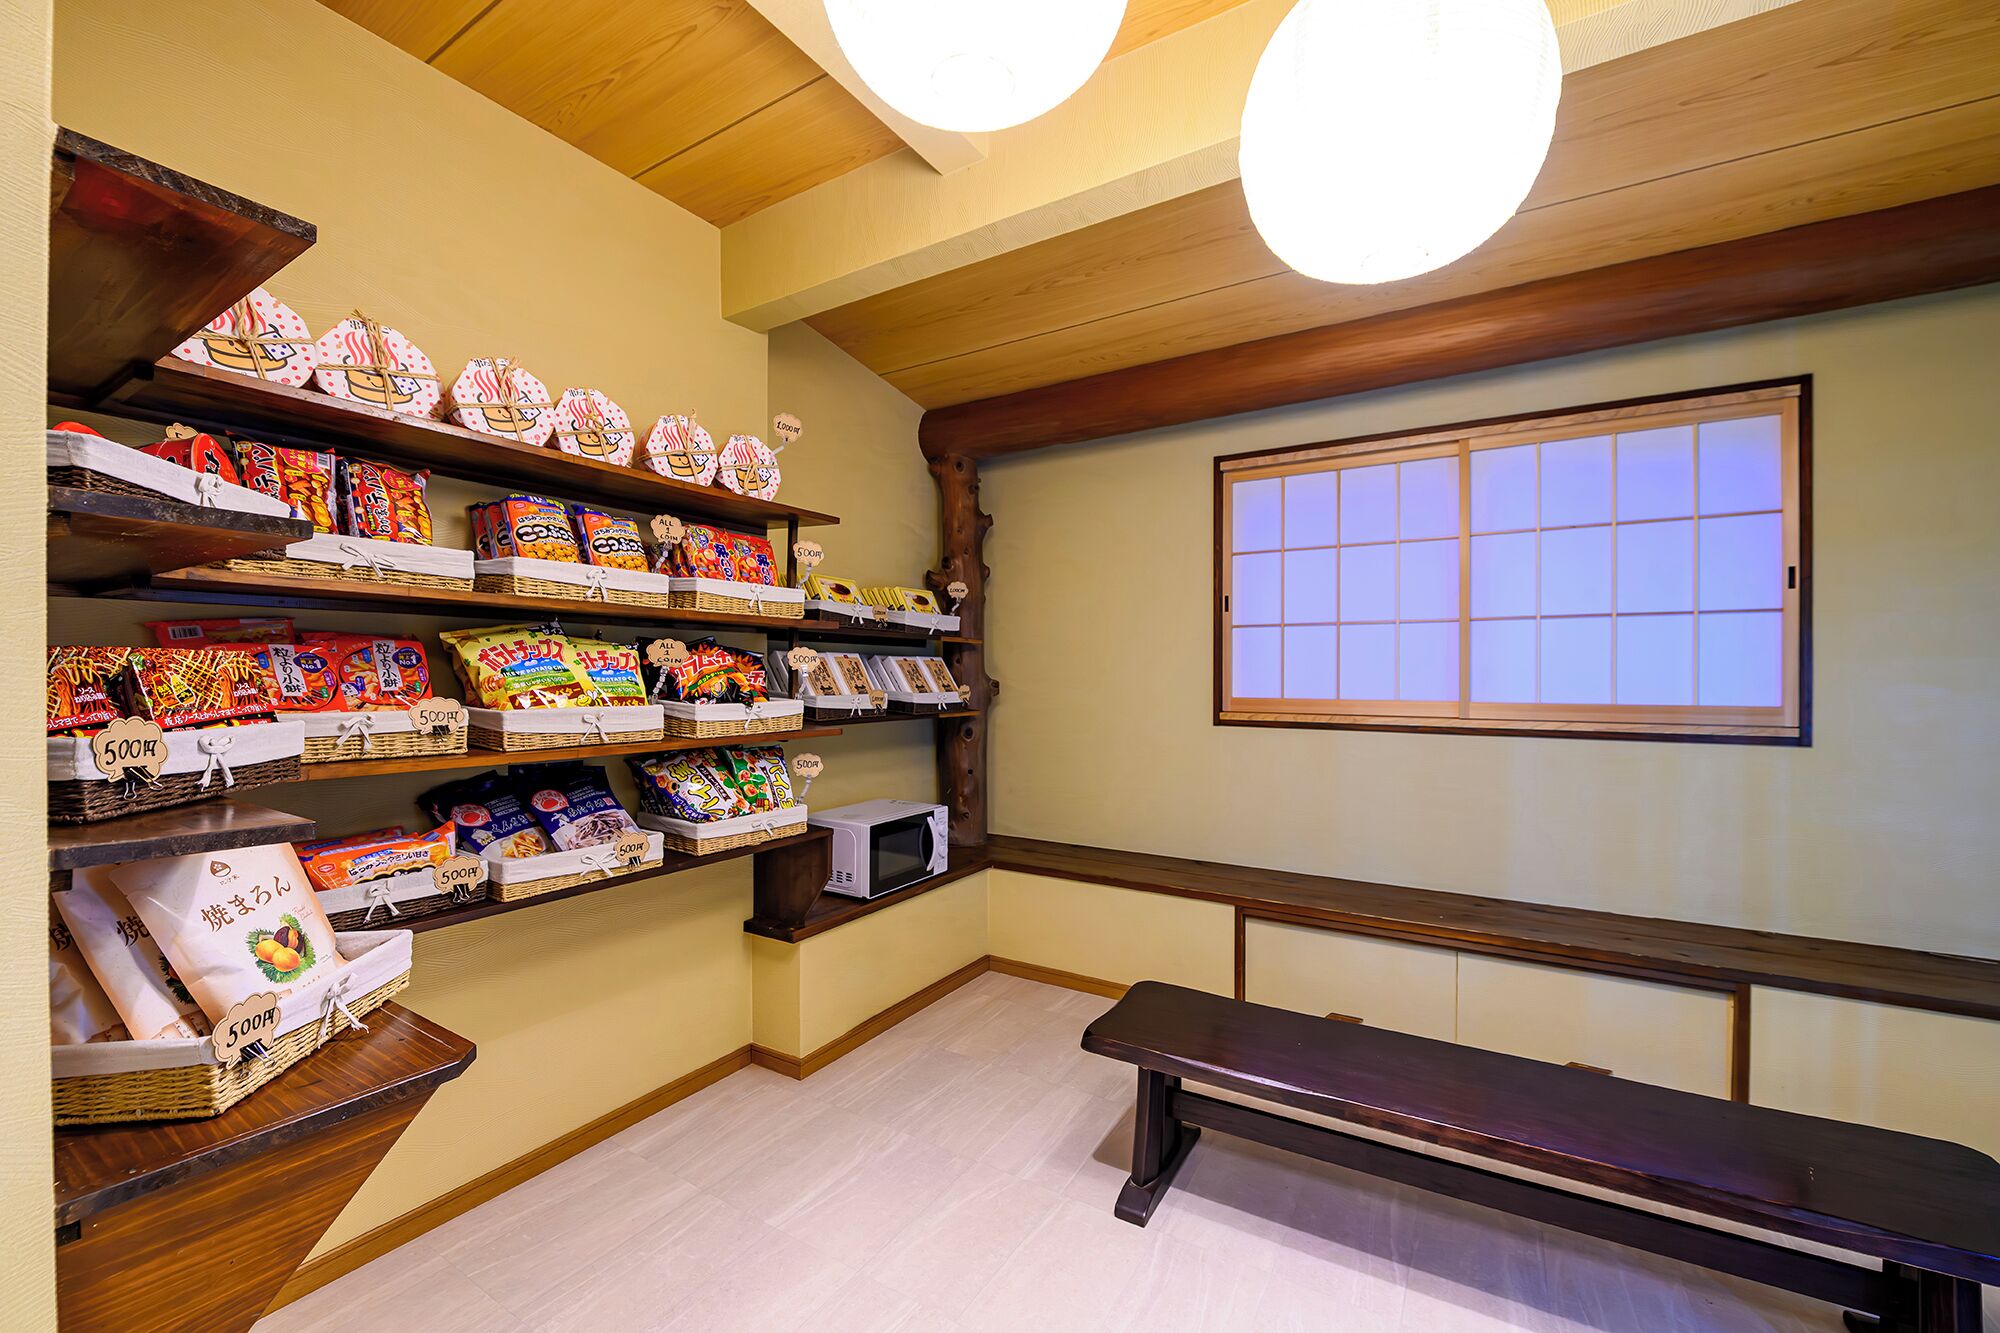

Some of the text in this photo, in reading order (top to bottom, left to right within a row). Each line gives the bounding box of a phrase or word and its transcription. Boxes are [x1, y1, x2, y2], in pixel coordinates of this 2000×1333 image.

[659, 518, 674, 527] ALL
[797, 547, 822, 560] 500円
[477, 639, 566, 673] ポテトチップス
[656, 656, 682, 664] COIN
[792, 653, 819, 664] 500円
[272, 647, 304, 693] 粒より小餅
[375, 642, 400, 688] 粒より小餅
[78, 687, 96, 695] ソース
[419, 709, 459, 726] 500円
[104, 739, 158, 766] 500円
[796, 759, 820, 770] 500円
[666, 758, 726, 817] パイの実
[619, 842, 645, 857] 500円
[440, 867, 478, 885] 500円
[200, 875, 292, 933] 焼まろん
[226, 1007, 276, 1048] 500円
